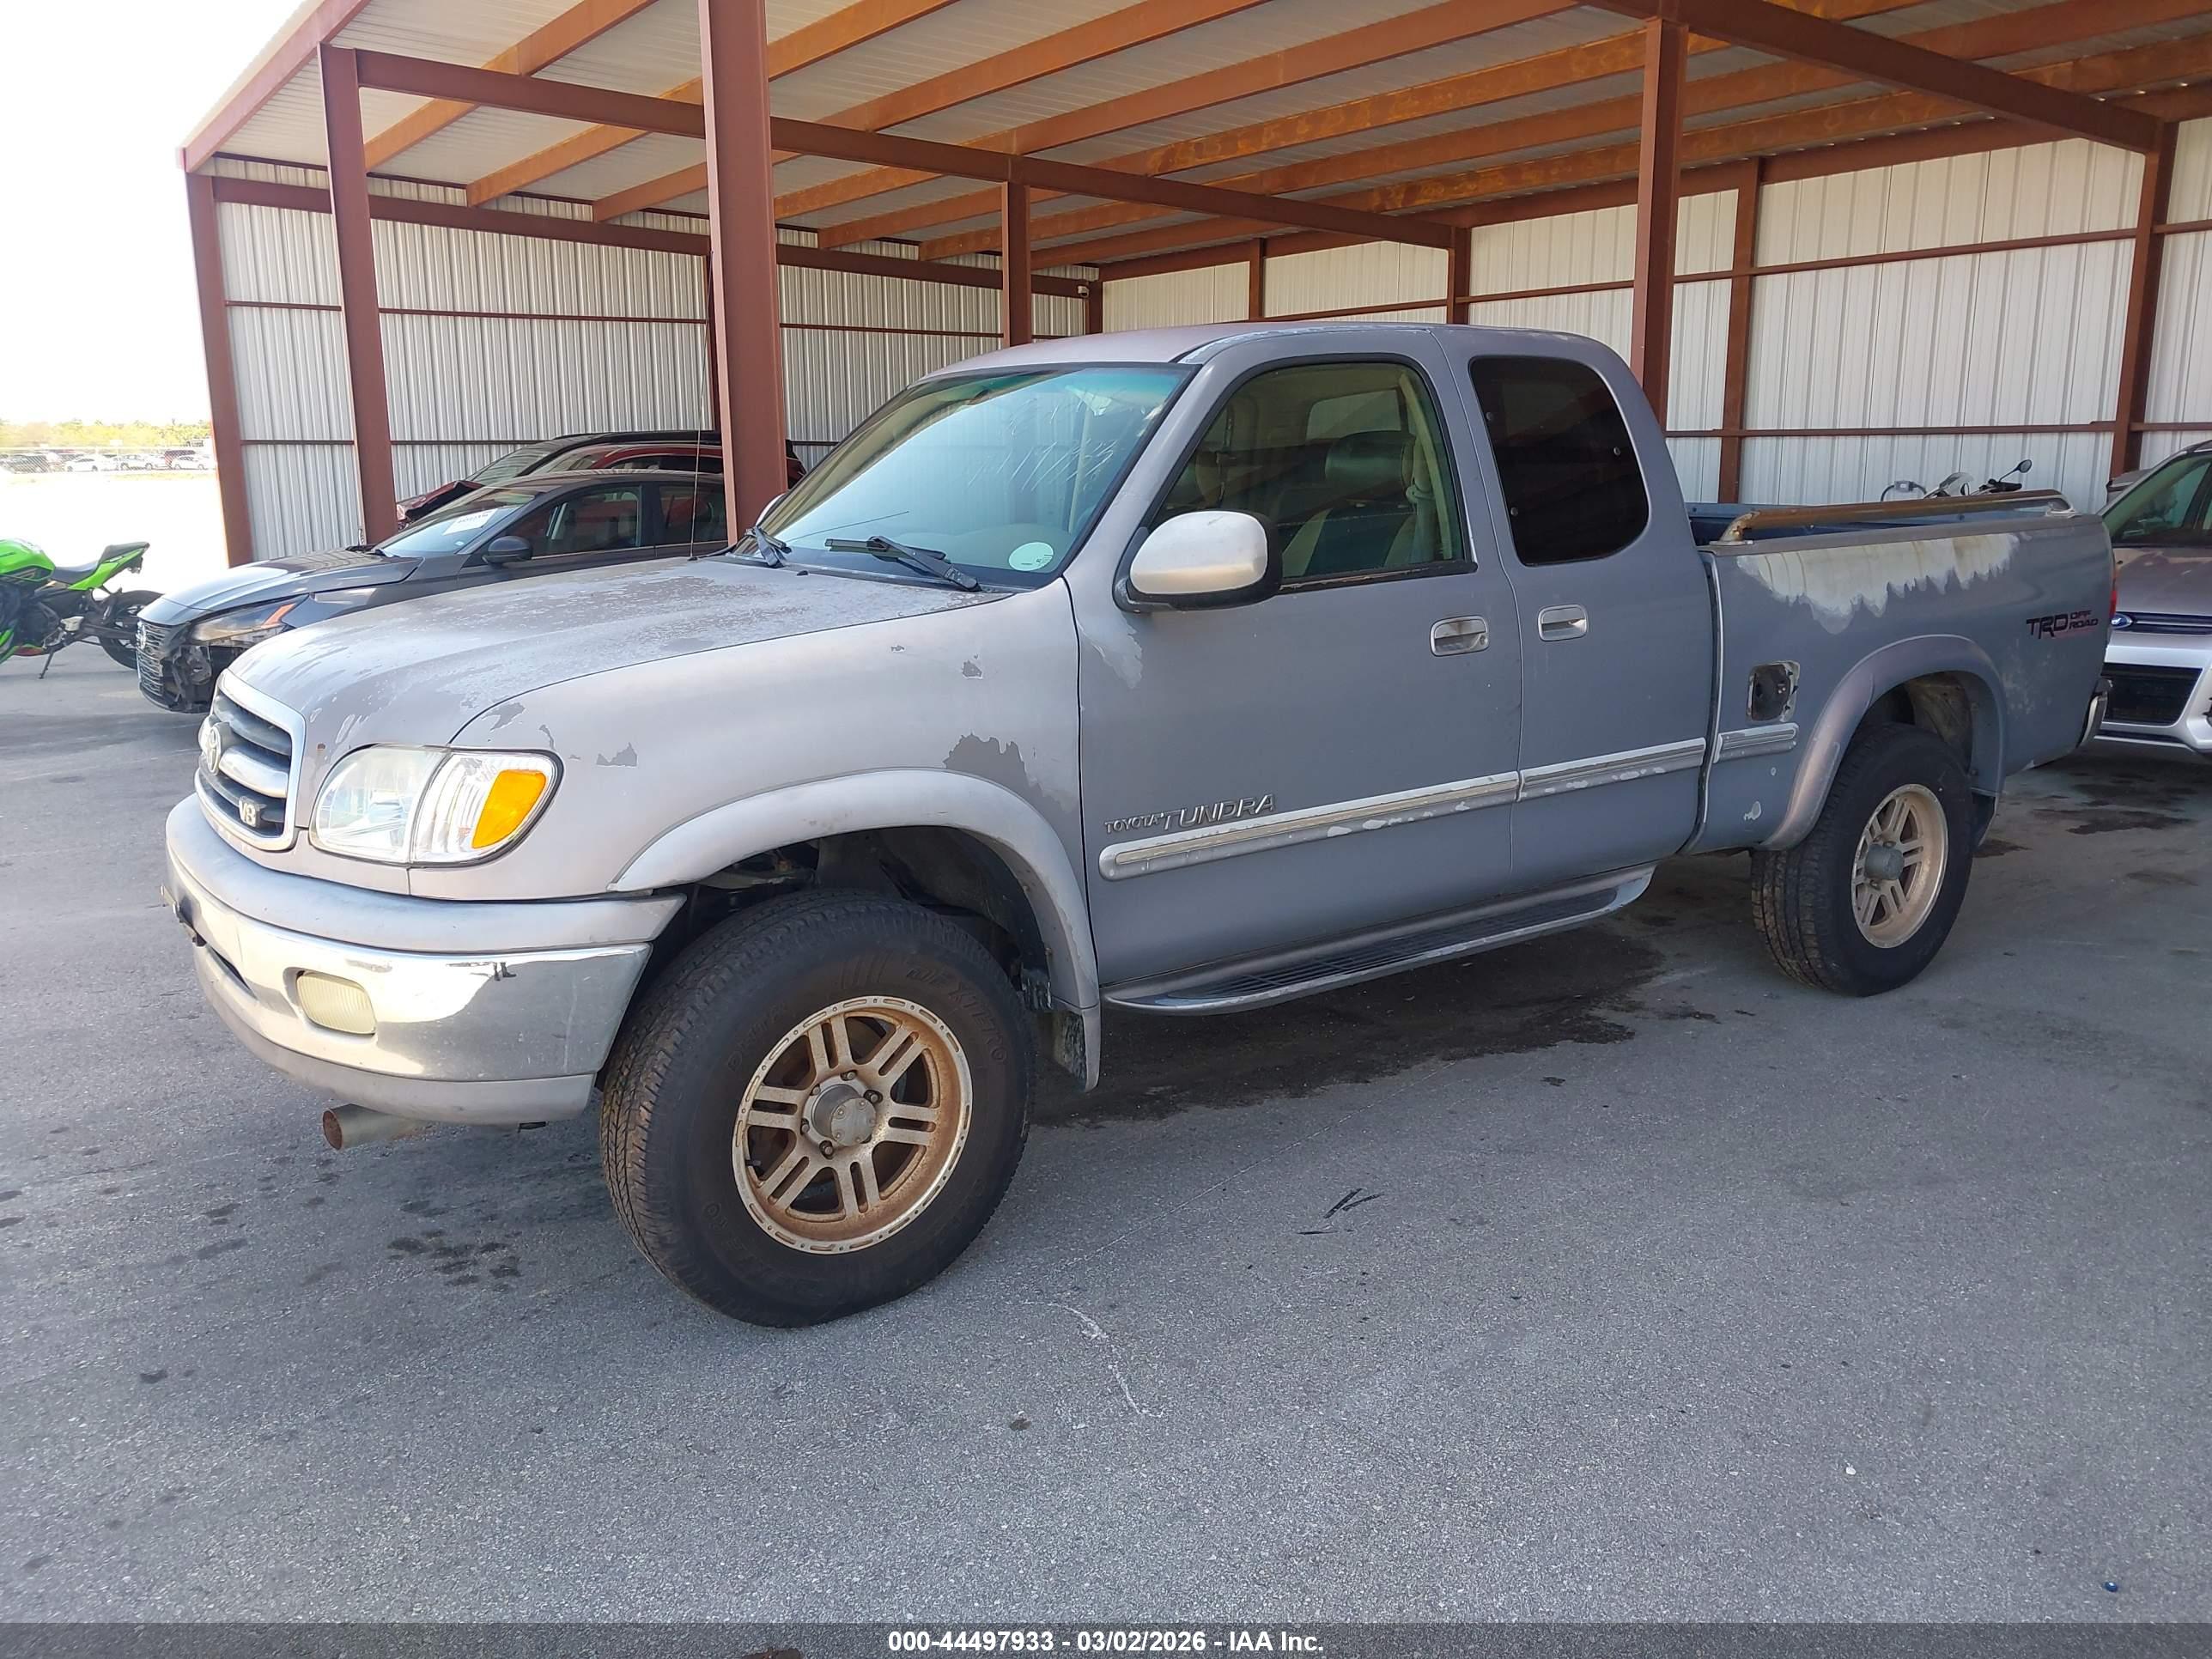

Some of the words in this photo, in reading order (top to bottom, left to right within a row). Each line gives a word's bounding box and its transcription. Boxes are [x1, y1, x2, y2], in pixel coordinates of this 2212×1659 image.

[2027, 615, 2068, 639] TRD
[2069, 611, 2091, 619] OFF
[2069, 618, 2098, 629] ROAD
[240, 798, 256, 827] V8
[1105, 814, 1158, 834] TOYOTA
[1161, 793, 1275, 830] TUNDRA
